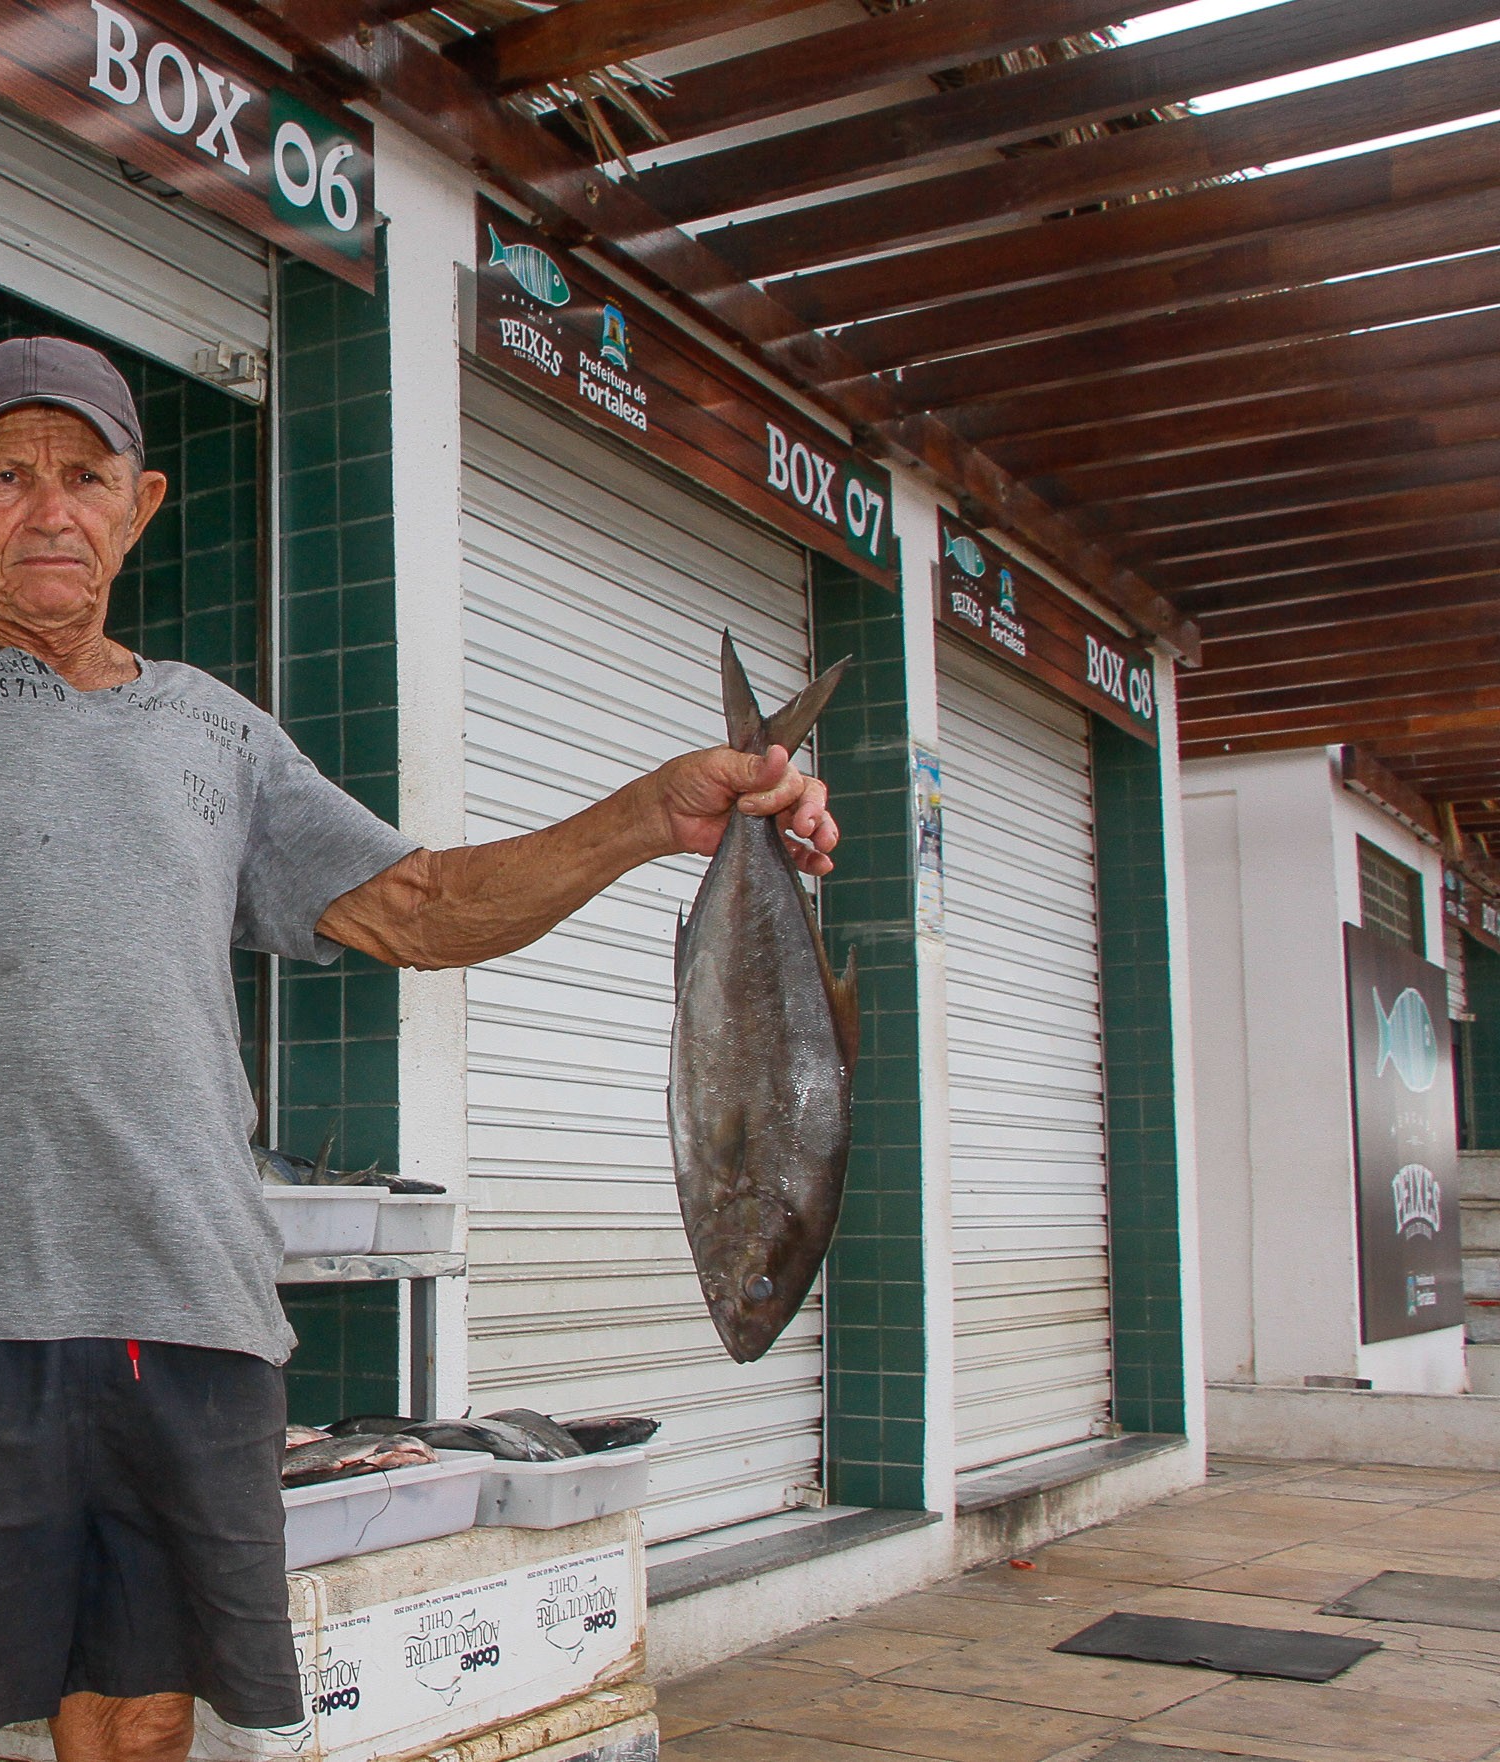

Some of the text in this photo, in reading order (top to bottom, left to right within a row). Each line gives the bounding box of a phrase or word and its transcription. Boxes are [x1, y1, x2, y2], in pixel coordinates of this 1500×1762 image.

[89, 0, 358, 231] BOX 06
[499, 318, 563, 377] PEIXES
[579, 351, 647, 405] Prefeitura de
[579, 371, 647, 431] Fortaleza
[766, 421, 884, 556] BOX 07
[1085, 634, 1153, 720] BOX 08
[205, 727, 231, 751] TRADE
[548, 1575, 578, 1596] CHILE
[419, 1609, 453, 1633] CHILE
[536, 1586, 618, 1629] AQUACULTURE
[583, 1608, 617, 1634] Cooke
[403, 1619, 501, 1669] AQUACULTURE
[460, 1644, 500, 1673] Cooke
[300, 1659, 362, 1697] AQUACU
[312, 1686, 361, 1717] Cooke
